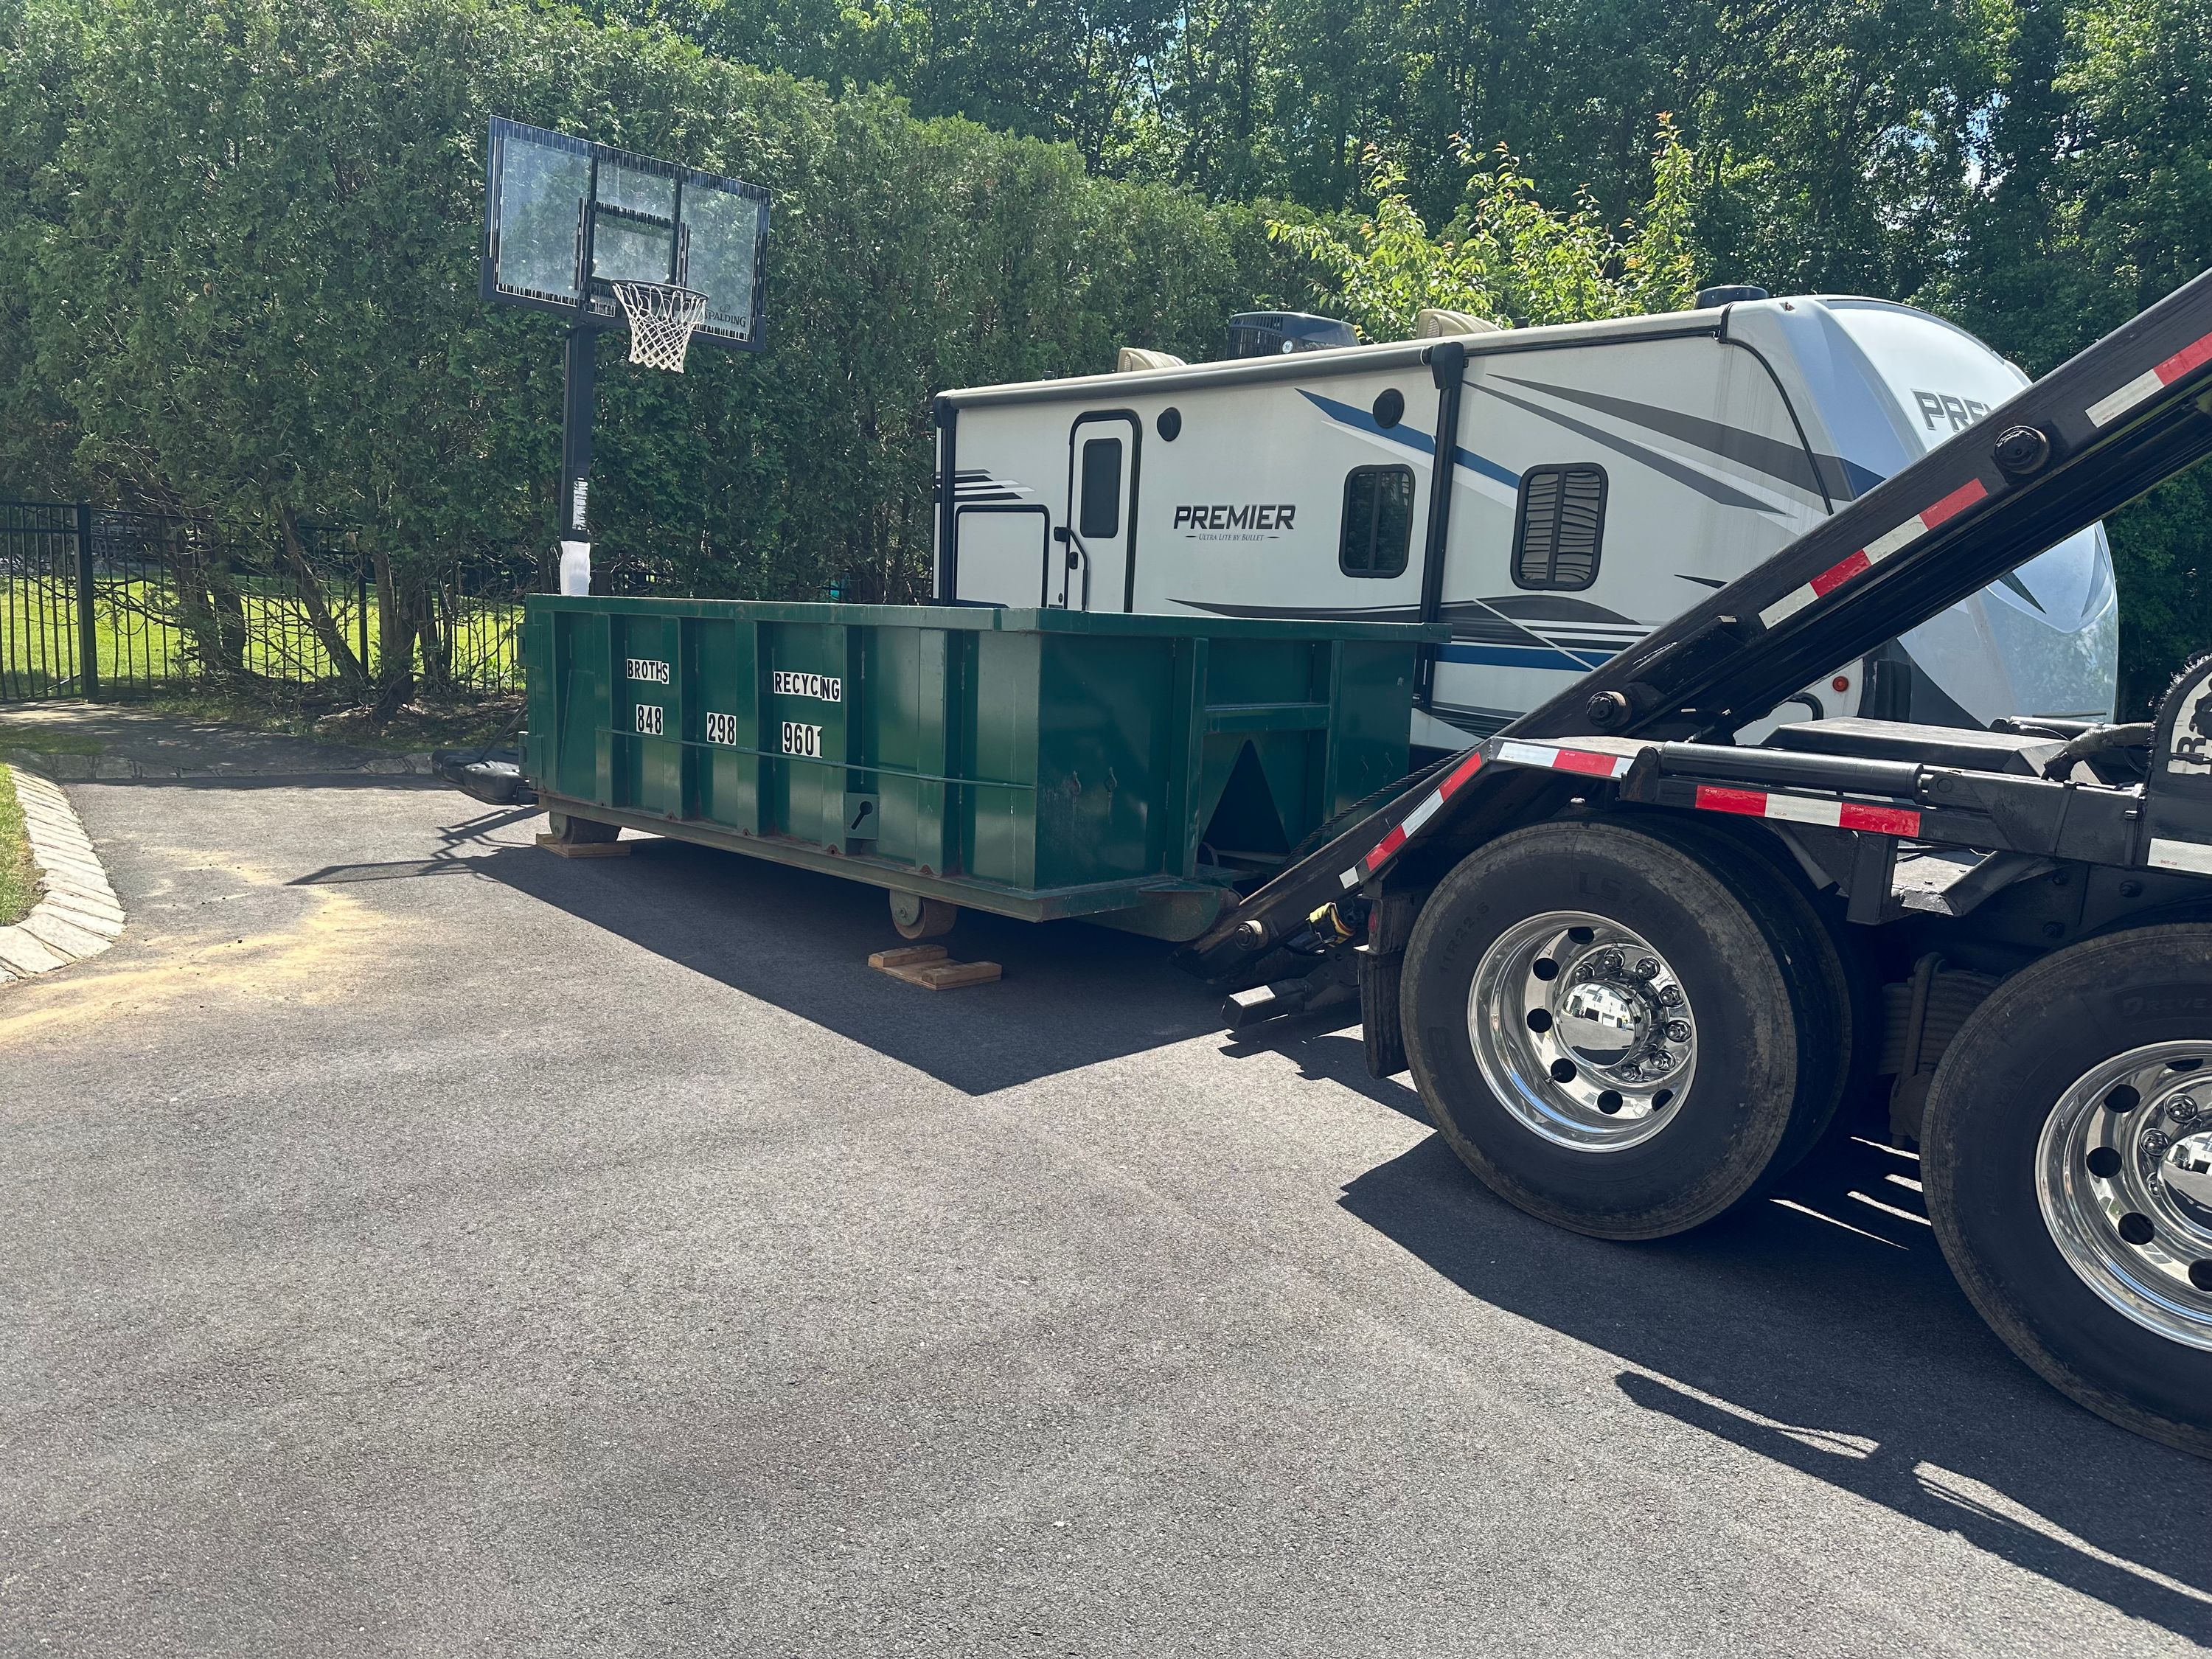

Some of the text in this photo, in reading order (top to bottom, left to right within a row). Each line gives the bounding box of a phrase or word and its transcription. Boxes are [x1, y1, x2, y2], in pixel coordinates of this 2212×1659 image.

[1910, 389, 1992, 432] PRE
[1173, 504, 1296, 530] PREMIER
[1218, 533, 1231, 541] LITE
[638, 706, 823, 757] 848 298 9601
